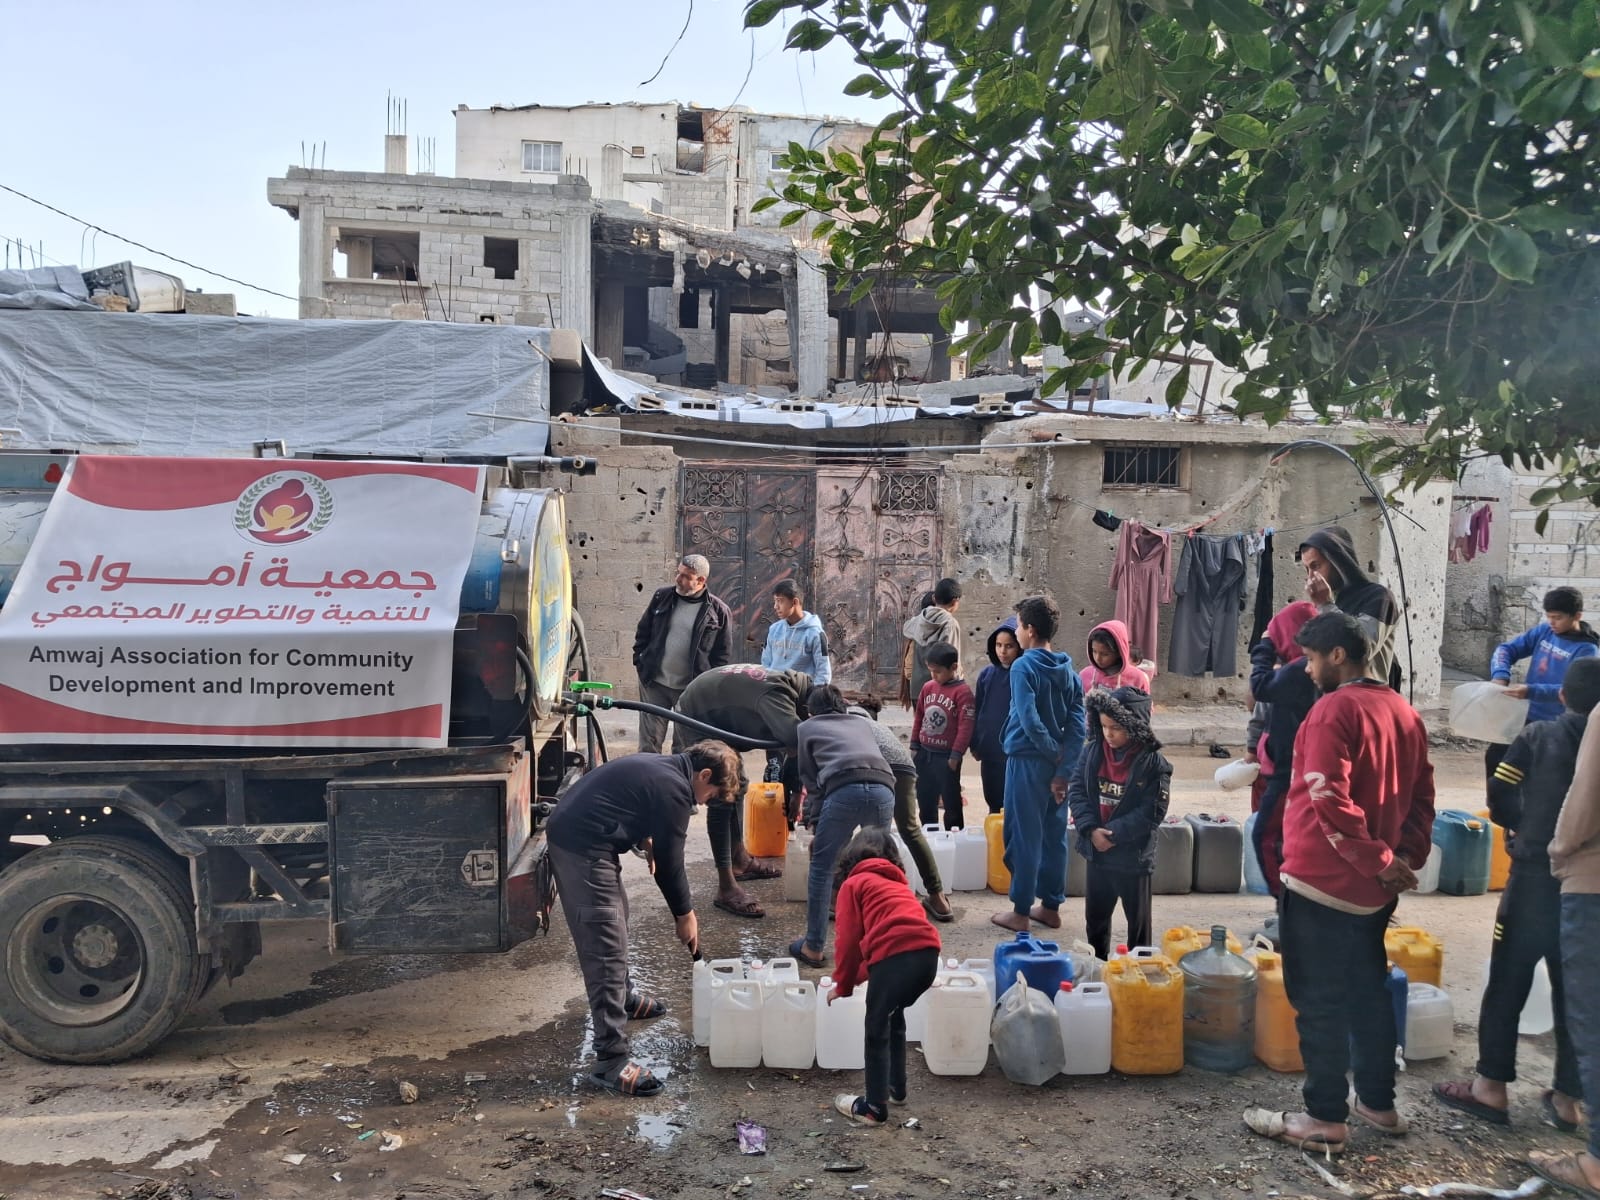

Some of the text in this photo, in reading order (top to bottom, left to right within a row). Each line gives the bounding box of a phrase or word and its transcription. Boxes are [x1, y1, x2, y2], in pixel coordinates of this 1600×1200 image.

[46, 551, 254, 594] أمواج
[259, 557, 437, 599] جمعية
[31, 602, 431, 628] للتنمية والتطوير المجتمعي
[28, 645, 414, 673] Amwaj Association for Community
[48, 674, 396, 699] Development and Improvement
[930, 711, 946, 727] 93
